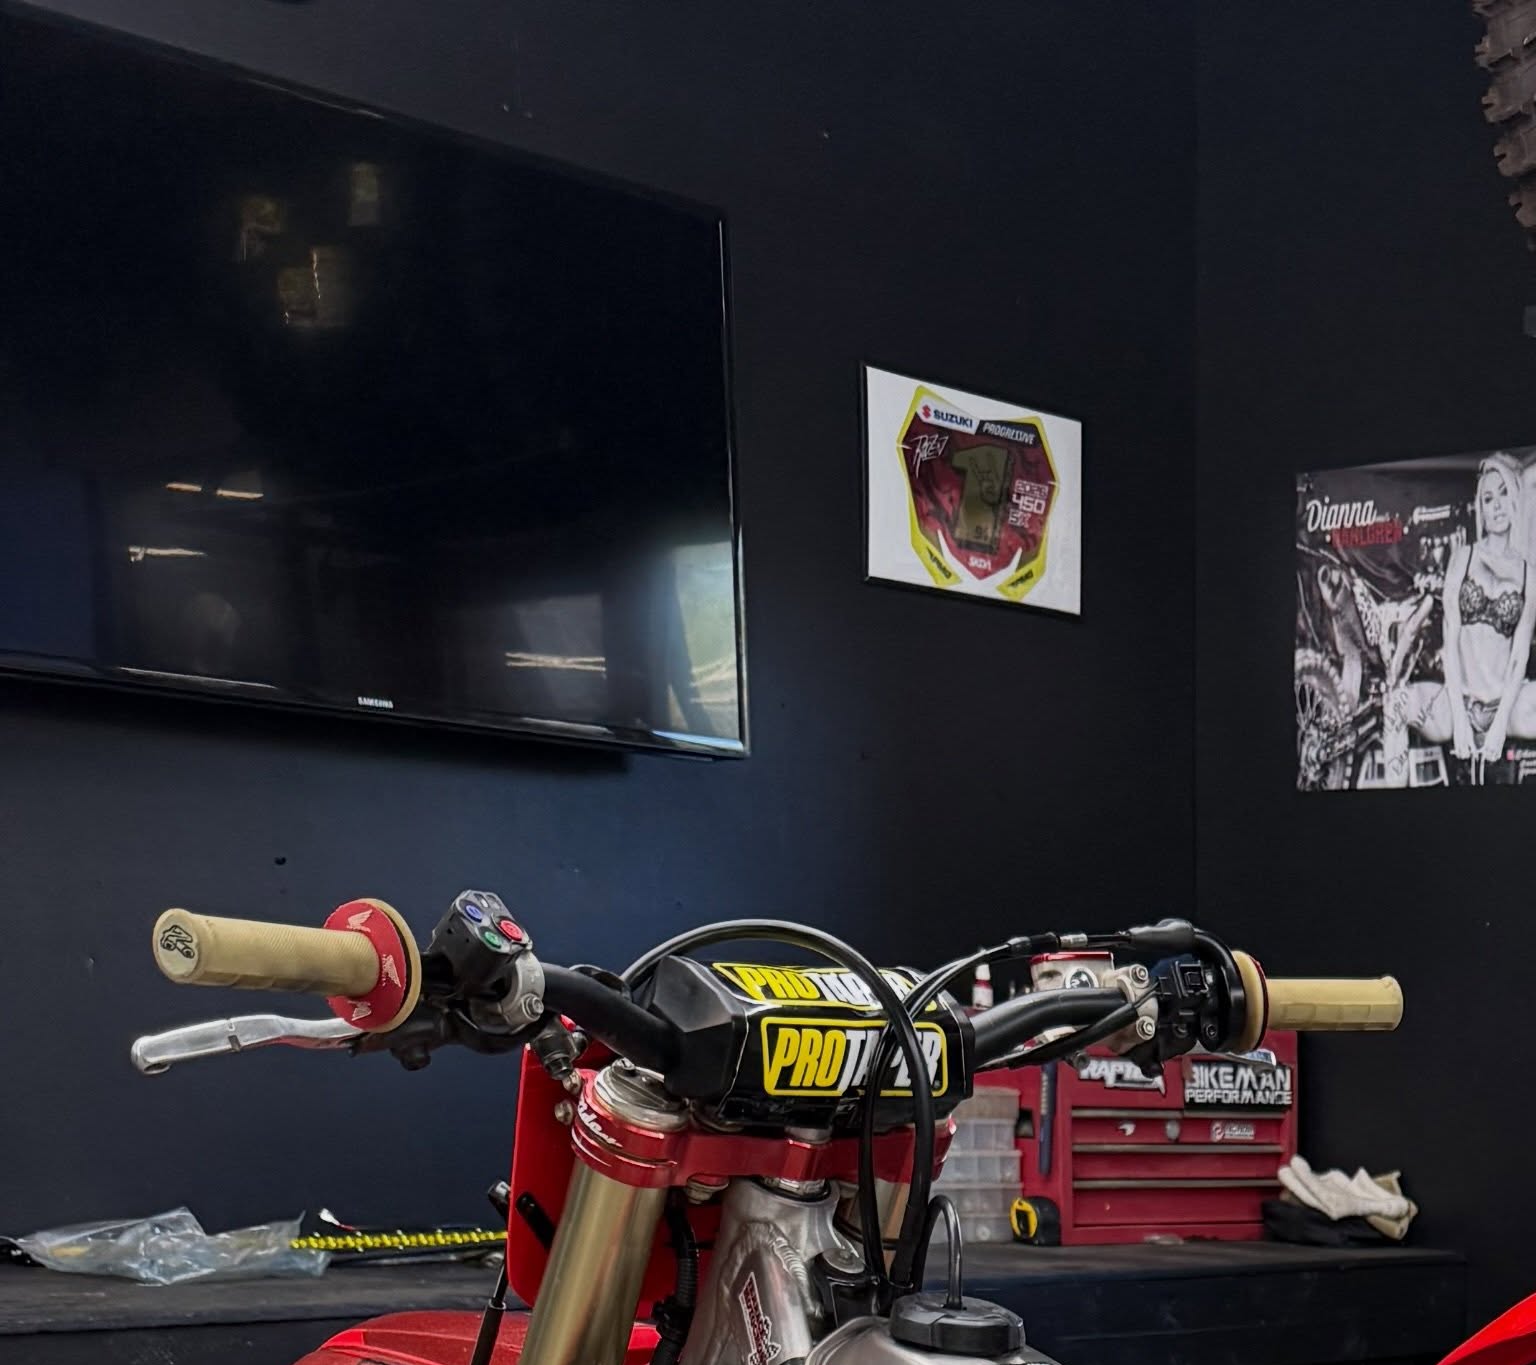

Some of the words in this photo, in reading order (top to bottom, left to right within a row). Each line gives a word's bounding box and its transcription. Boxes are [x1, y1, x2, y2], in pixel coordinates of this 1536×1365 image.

[933, 408, 973, 428] SUZUKI
[983, 422, 1036, 445] PROGRESSIVE
[1012, 494, 1046, 515] 450
[1306, 496, 1377, 533] Dianna
[1186, 1064, 1292, 1089] BIKEMAN
[1185, 1087, 1292, 1105] PERFORMANCE
